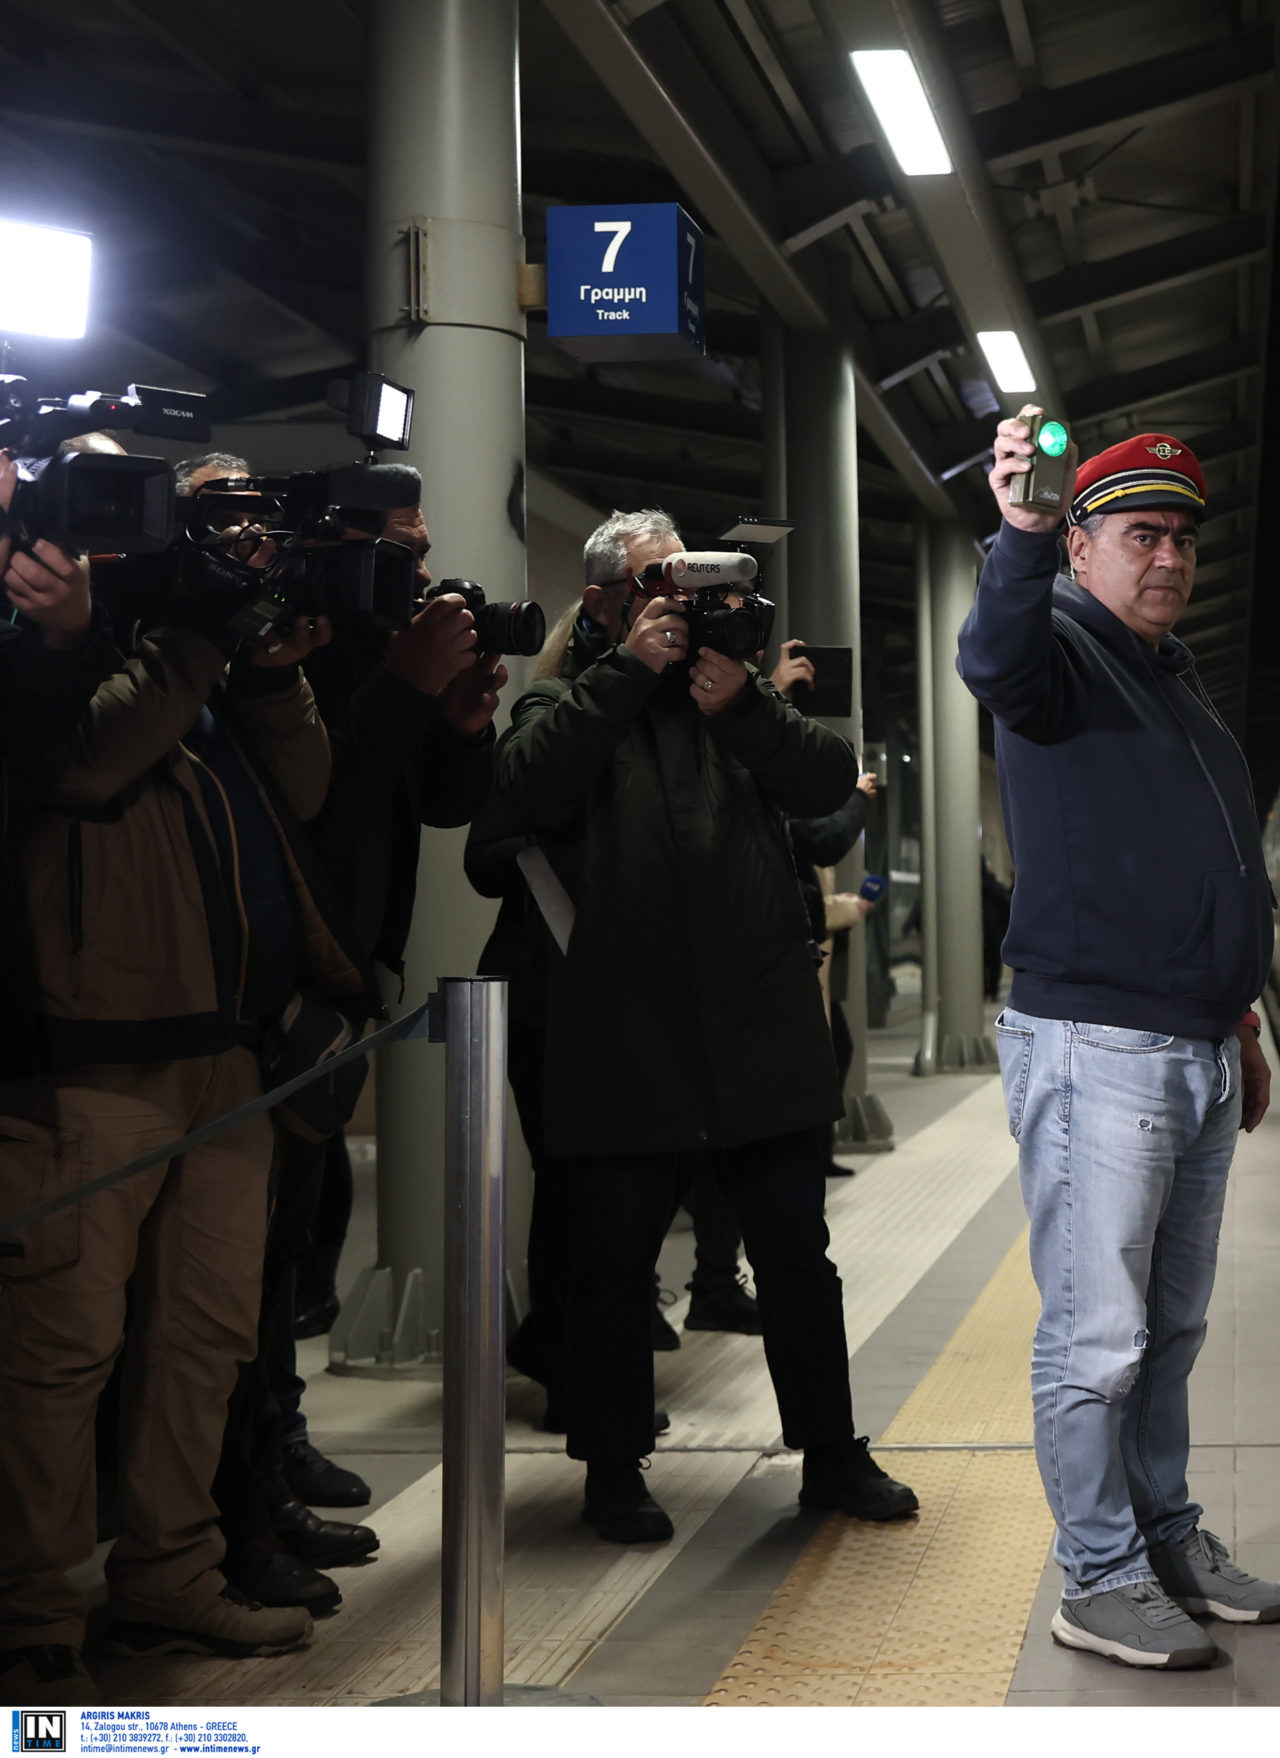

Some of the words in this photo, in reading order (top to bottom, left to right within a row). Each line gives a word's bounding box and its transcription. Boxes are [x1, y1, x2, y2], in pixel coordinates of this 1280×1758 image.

[594, 221, 632, 273] 7
[686, 231, 697, 284] 7
[580, 285, 646, 304] Γραμμη
[596, 309, 630, 320] Track
[688, 563, 720, 573] REUTERS
